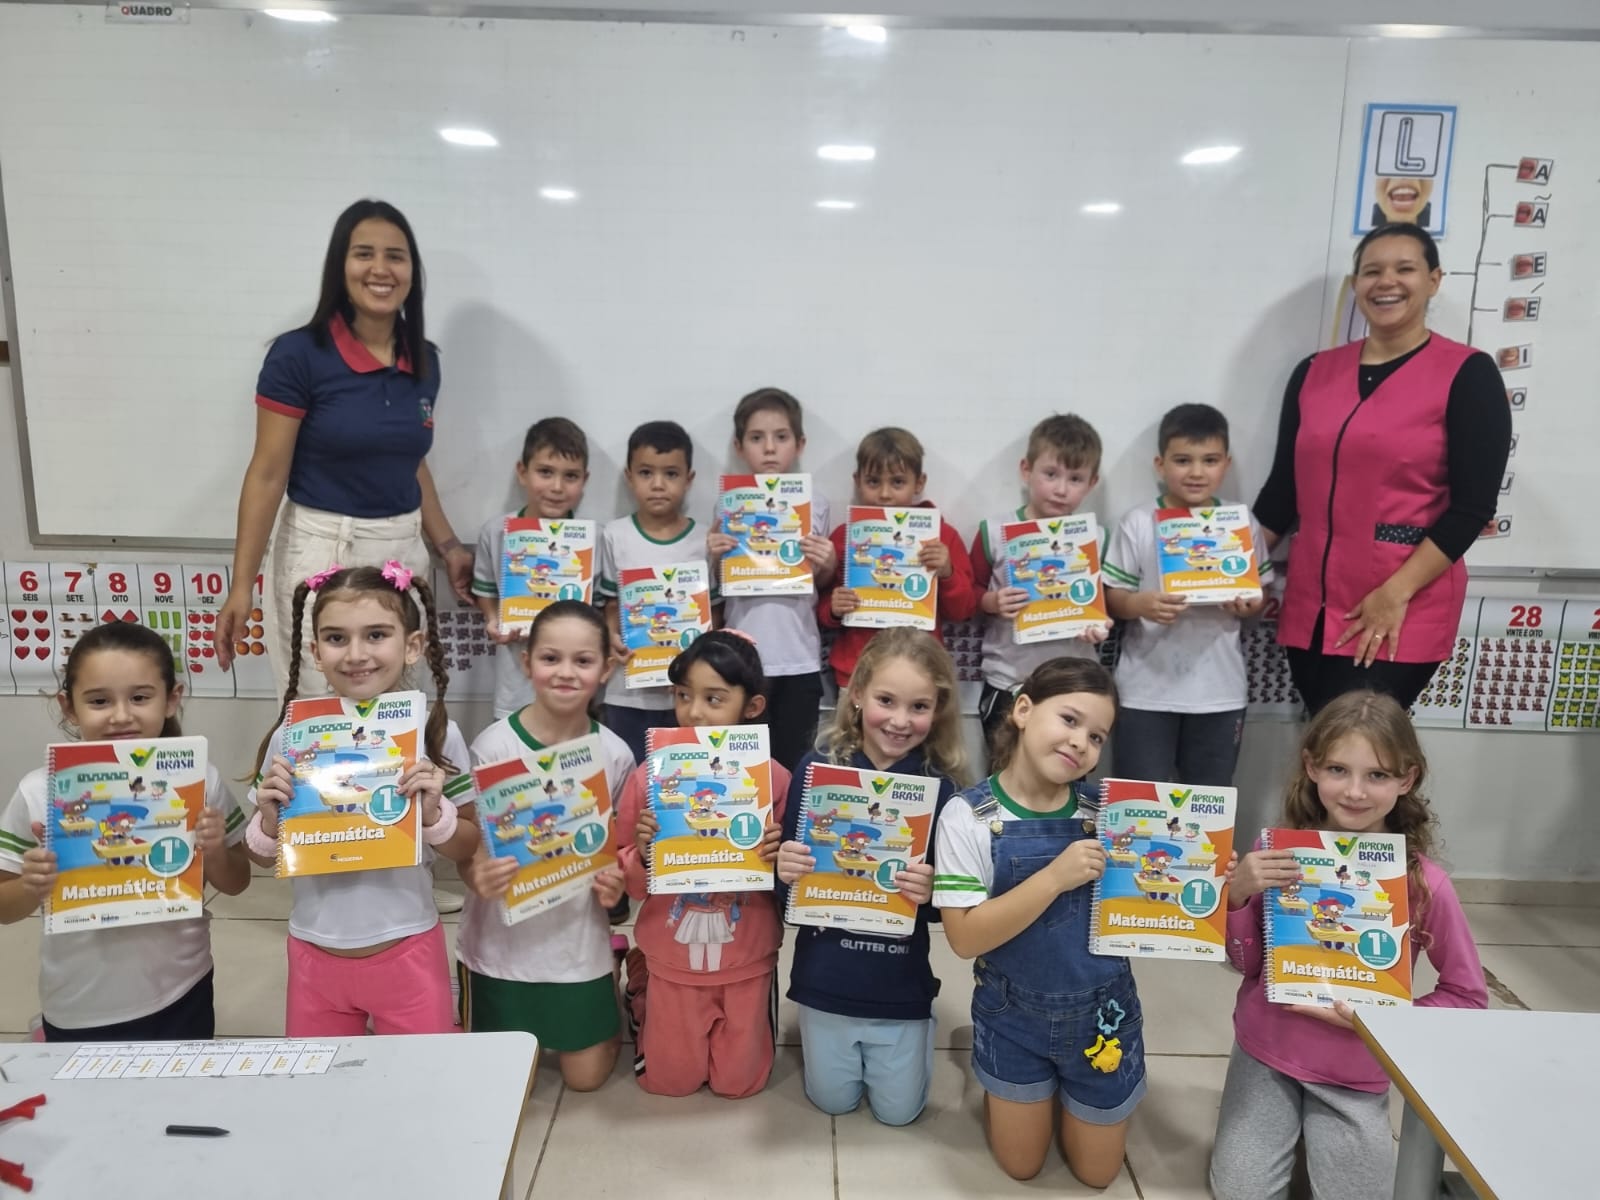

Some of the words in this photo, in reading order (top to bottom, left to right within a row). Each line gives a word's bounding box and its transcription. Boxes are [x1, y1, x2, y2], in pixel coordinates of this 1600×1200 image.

[121, 6, 172, 16] QUADRO
[1395, 117, 1426, 172] L
[1534, 164, 1550, 180] A
[1533, 255, 1545, 274] E
[1511, 391, 1525, 406] O
[1498, 519, 1511, 533] O
[19, 570, 39, 592] 6
[64, 571, 82, 593] 7
[108, 572, 127, 594] 8
[153, 573, 172, 594] 9
[191, 573, 222, 595] 10
[22, 594, 39, 602] SEIS
[66, 594, 84, 603] SETE
[112, 595, 128, 603] OITO
[155, 595, 174, 604] NOVE
[201, 596, 215, 605] DEZ
[1508, 605, 1542, 628] 28
[1506, 629, 1523, 637] VINTE
[1528, 629, 1543, 638] OITO
[378, 700, 411, 710] APROVA
[377, 708, 411, 720] BRASIL
[729, 733, 758, 742] APROVA
[729, 741, 759, 751] BRASIL
[157, 749, 194, 759] APROVA
[156, 758, 194, 770] BRASIL
[893, 782, 925, 792] APROVA
[891, 790, 924, 802] BRASIL
[1191, 794, 1225, 804] APROVA
[1191, 803, 1225, 815] BRASIL
[290, 825, 386, 846] Matemática
[1359, 841, 1394, 852] APROVA
[663, 849, 745, 867] Matemática
[1359, 851, 1396, 863] BRASIL
[512, 858, 593, 897] Matemática
[62, 877, 167, 901] Matemática
[804, 886, 888, 904] Matemática
[1108, 912, 1196, 931] Matemática
[840, 938, 885, 952] GLITTER
[1282, 960, 1377, 983] Matemática
